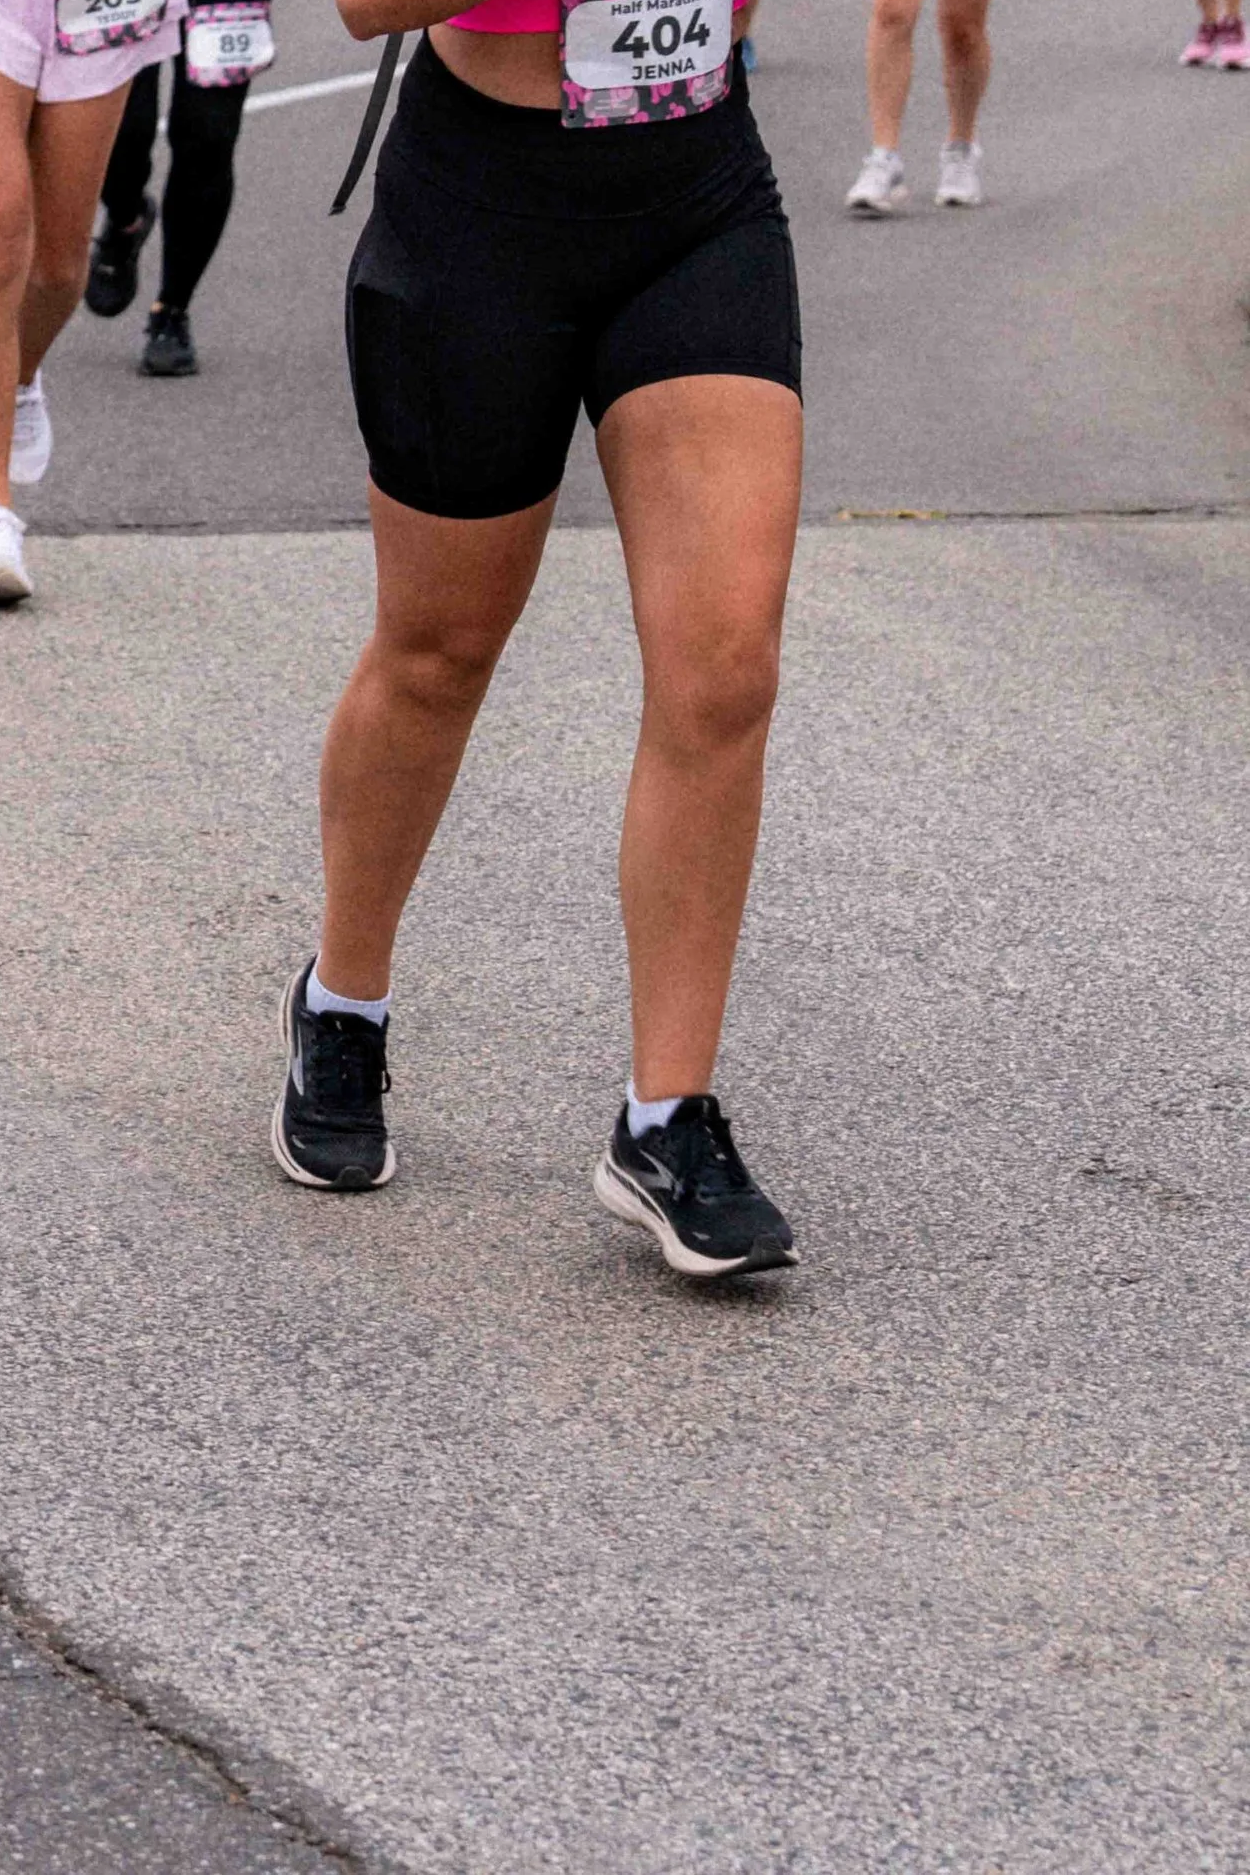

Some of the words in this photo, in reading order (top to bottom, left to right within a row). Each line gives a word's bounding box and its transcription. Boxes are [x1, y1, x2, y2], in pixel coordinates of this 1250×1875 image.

[611, 0, 642, 15] Half
[220, 33, 250, 53] 89
[612, 7, 710, 58] 404
[632, 57, 696, 80] JENNA
